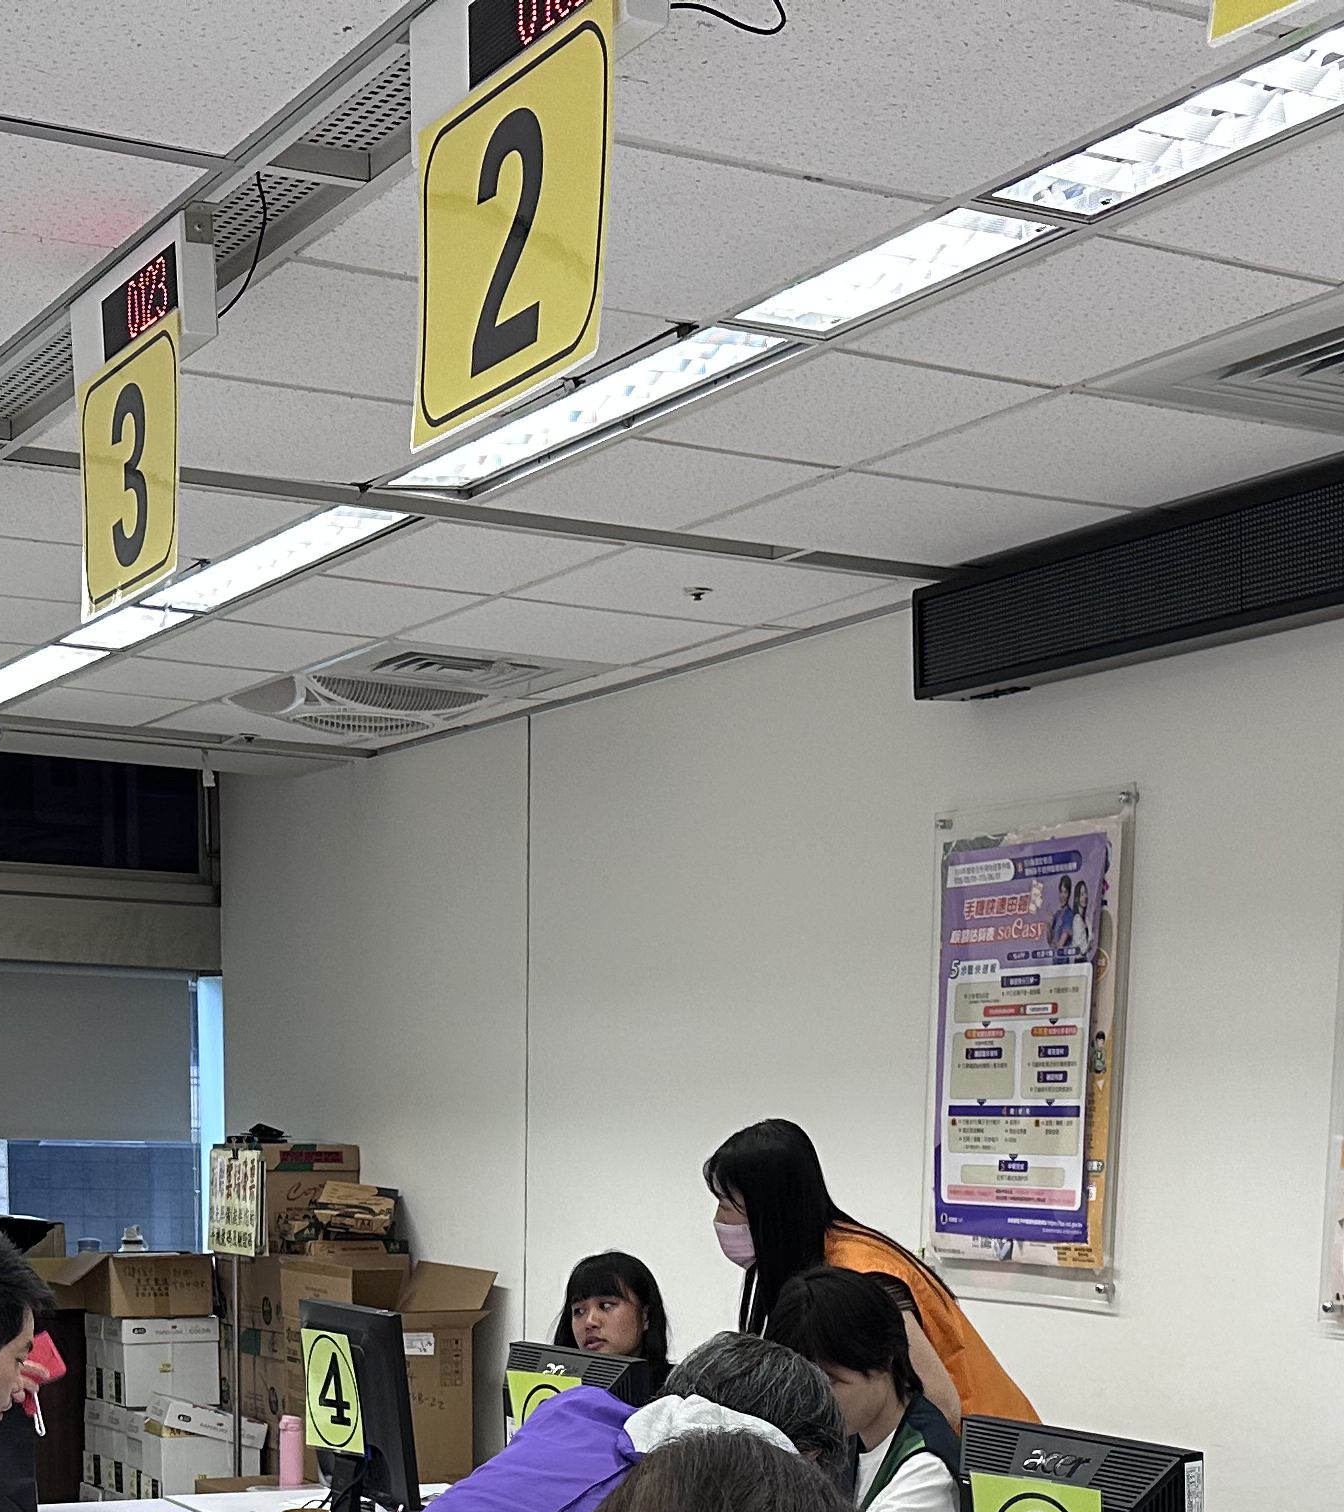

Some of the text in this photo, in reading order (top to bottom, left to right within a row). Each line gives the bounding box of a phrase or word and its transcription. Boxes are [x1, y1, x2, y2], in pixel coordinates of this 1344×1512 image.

[471, 107, 544, 378] 2
[111, 382, 148, 568] 3
[319, 1352, 352, 1426] 4
[1022, 1449, 1092, 1479] acer
